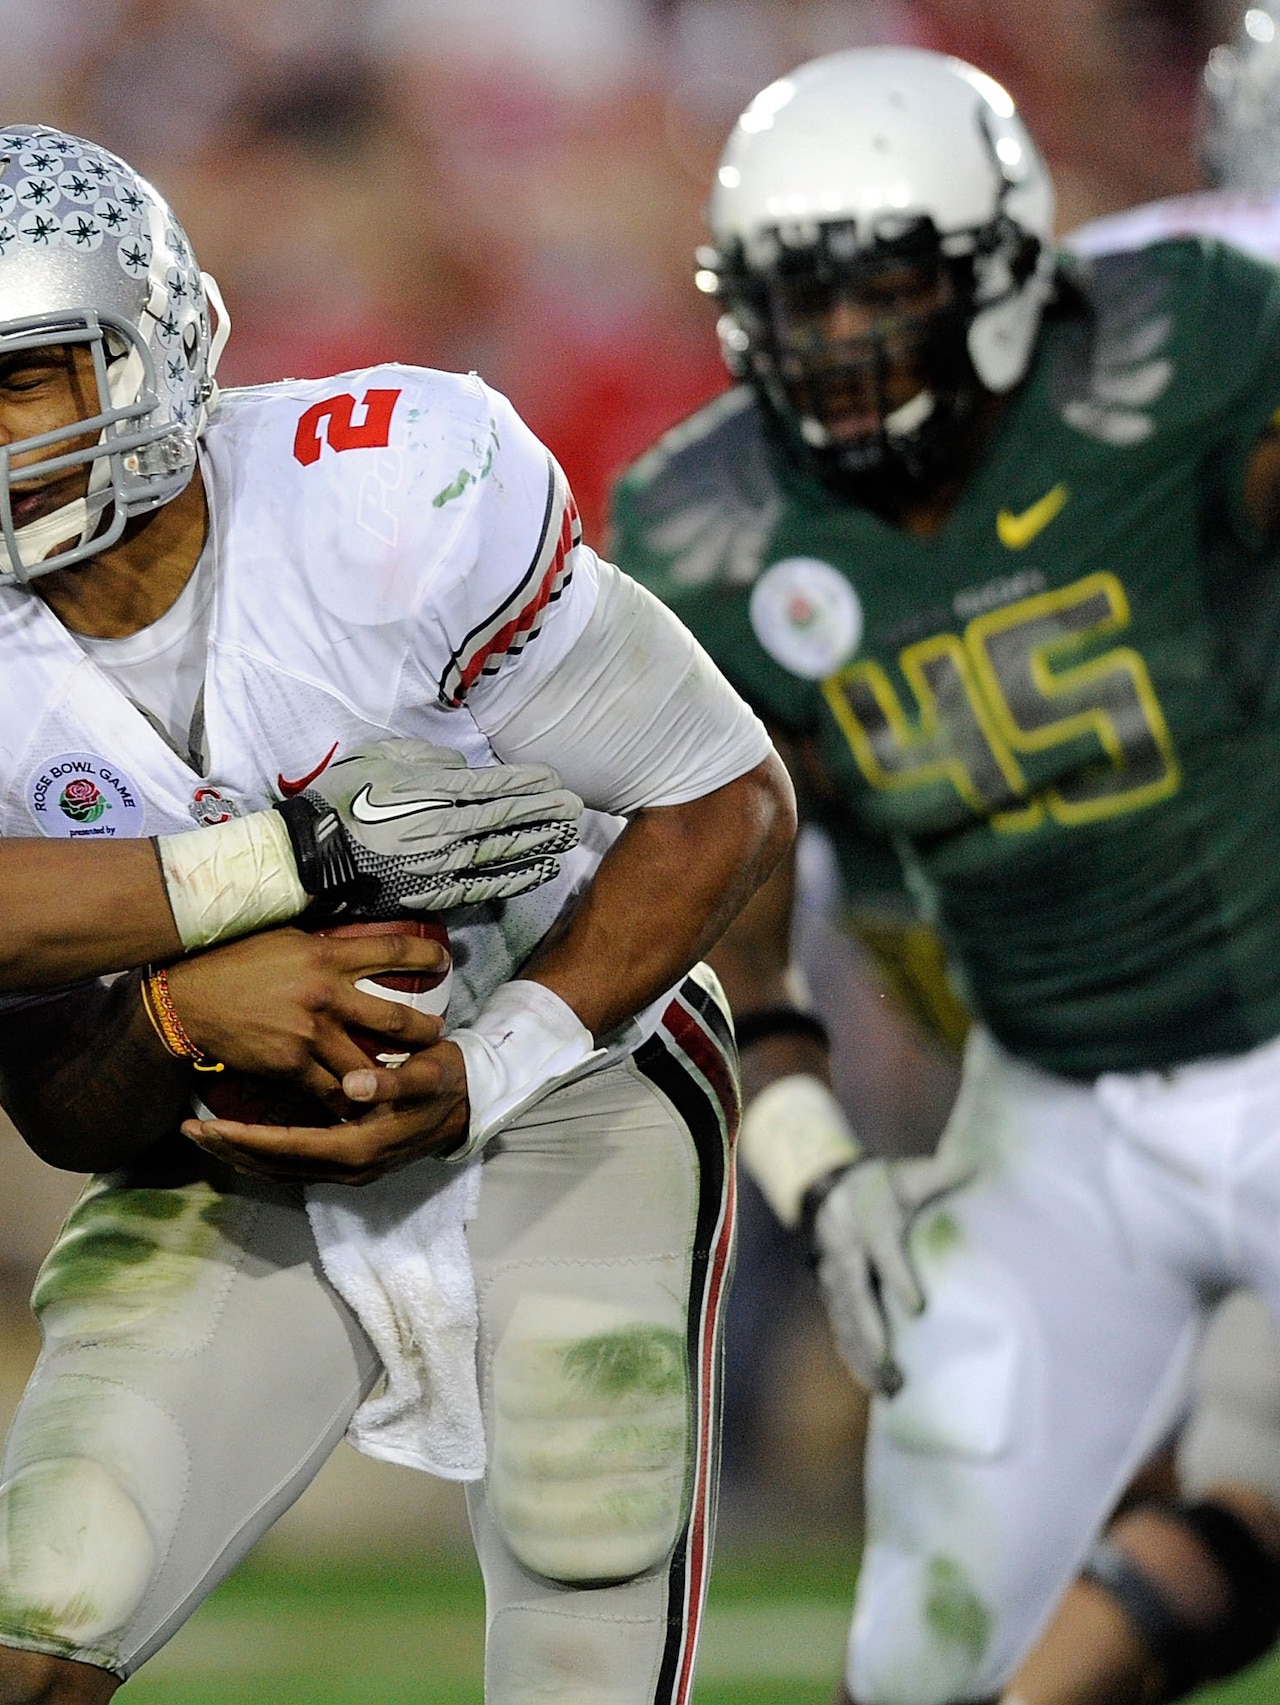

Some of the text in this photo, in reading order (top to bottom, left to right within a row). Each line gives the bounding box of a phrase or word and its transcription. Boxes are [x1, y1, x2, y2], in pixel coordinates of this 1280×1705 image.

[293, 389, 402, 467] 2
[823, 571, 1181, 834] 45
[33, 762, 136, 811] ROSE BOWL GAME
[70, 825, 116, 838] presented by
